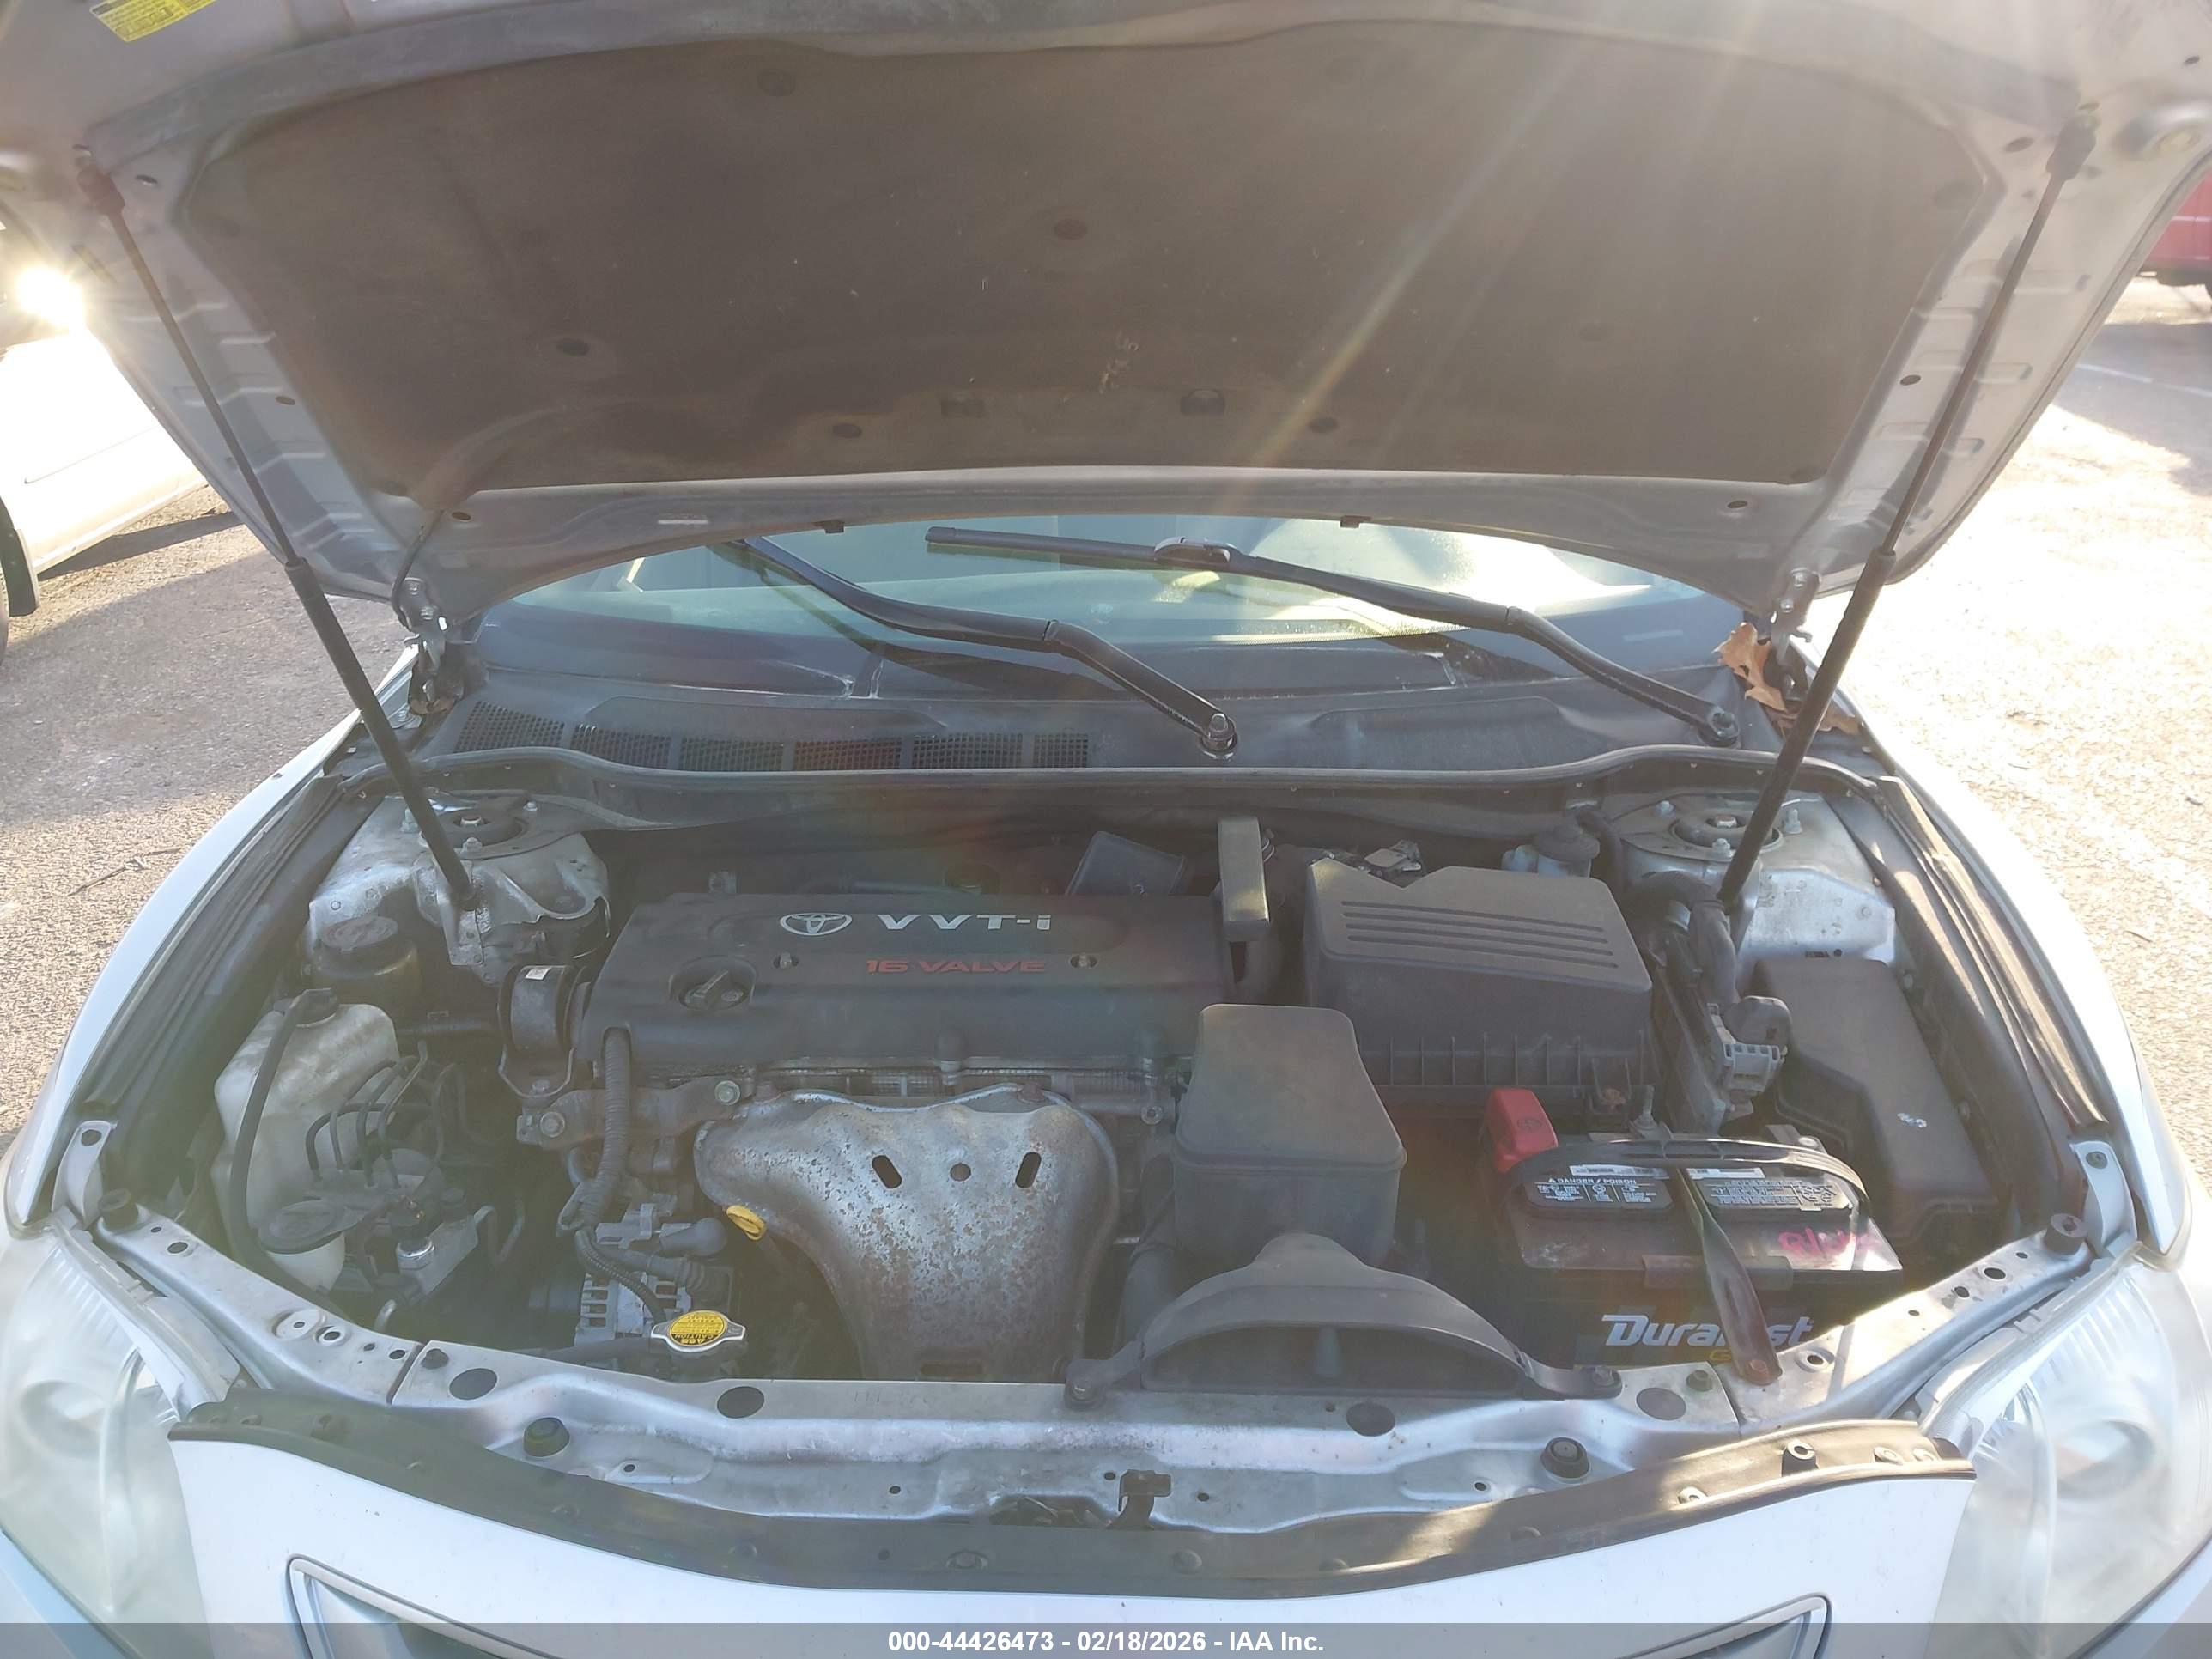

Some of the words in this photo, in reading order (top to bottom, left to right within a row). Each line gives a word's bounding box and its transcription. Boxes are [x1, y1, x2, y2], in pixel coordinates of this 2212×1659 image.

[866, 959, 909, 974] 16
[918, 959, 1047, 973] VALVE
[1601, 1314, 1814, 1347] Durast
